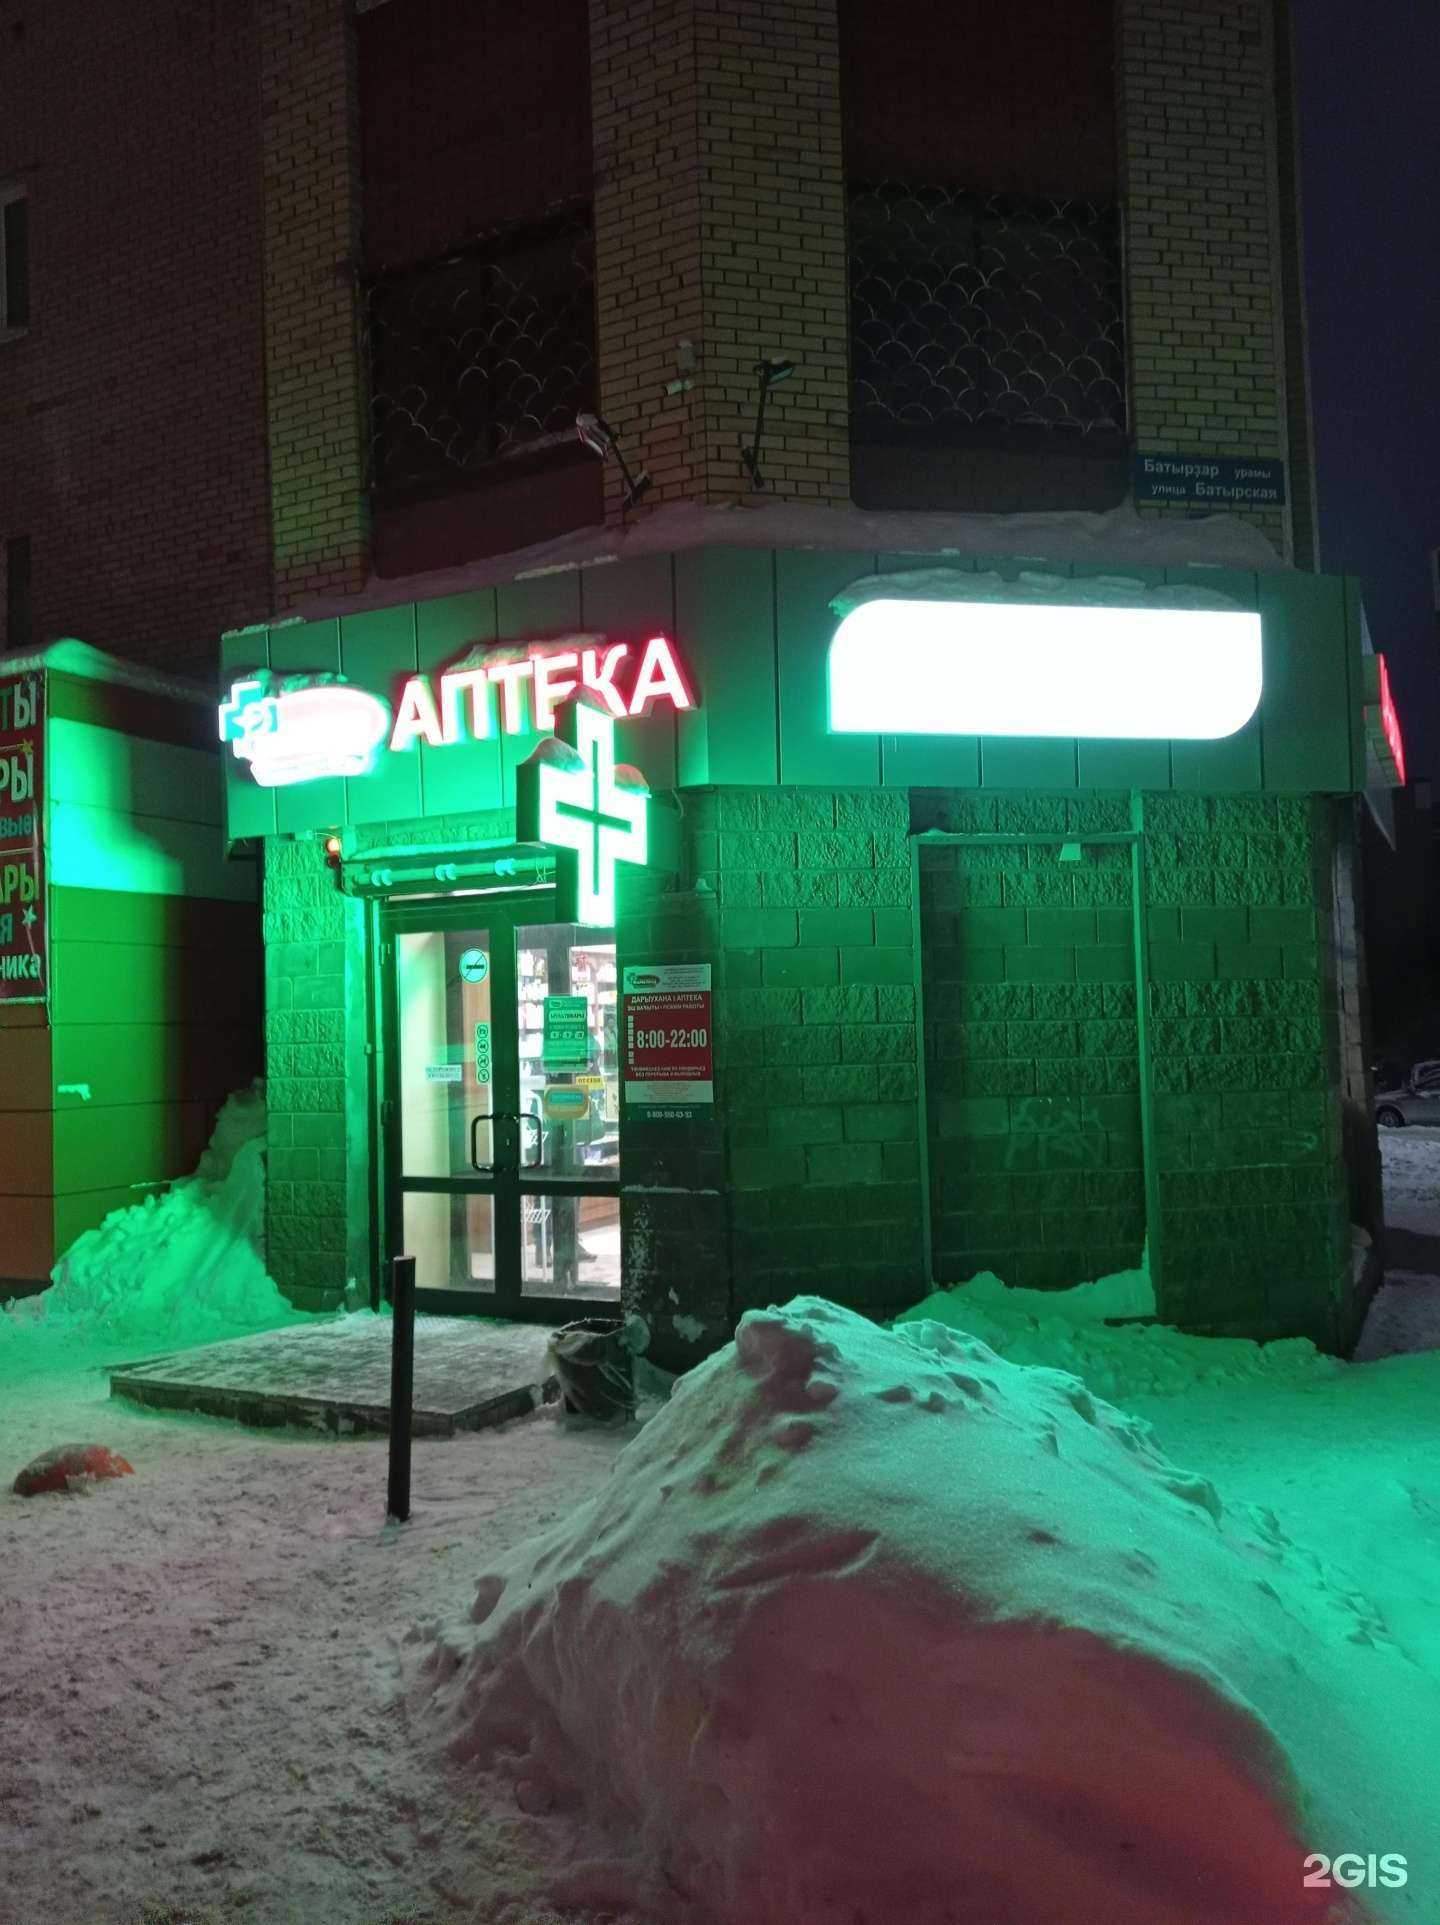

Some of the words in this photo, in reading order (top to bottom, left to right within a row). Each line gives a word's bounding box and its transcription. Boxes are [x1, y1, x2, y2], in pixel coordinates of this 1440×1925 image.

[1233, 467, 1272, 481] урамы
[1151, 483, 1186, 496] улица
[1195, 482, 1278, 499] Батырская
[390, 636, 691, 751] АПТЕКА
[677, 993, 703, 1002] АПТЕКА
[636, 1028, 708, 1049] 8:00-22:00
